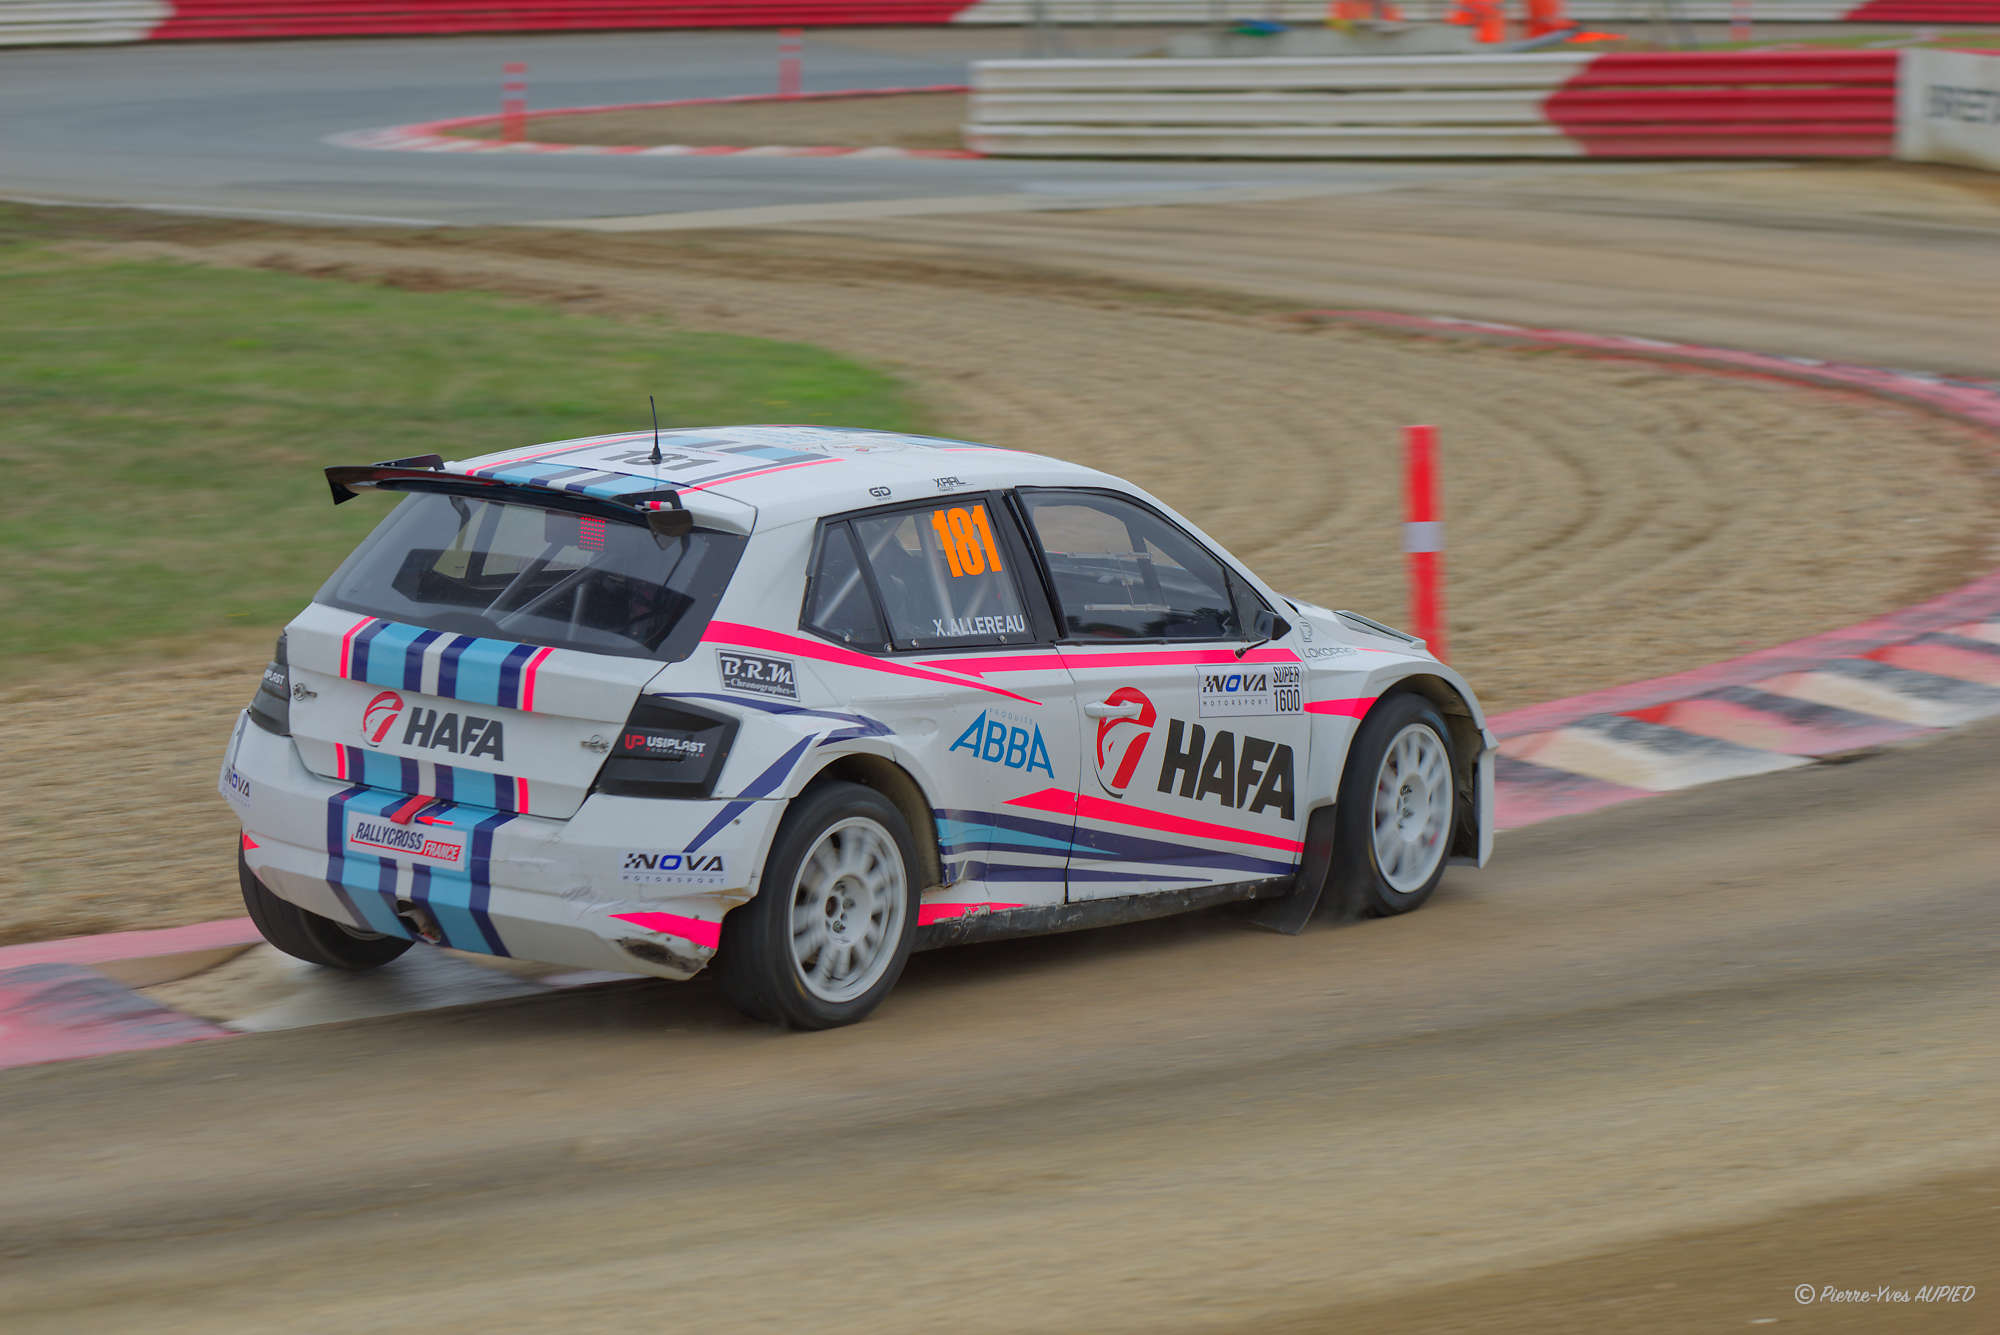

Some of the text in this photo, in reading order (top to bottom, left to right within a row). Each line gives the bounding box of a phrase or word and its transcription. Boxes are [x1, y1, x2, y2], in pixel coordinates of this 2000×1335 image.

[932, 505, 1002, 578] 181
[932, 614, 1025, 637] X.ALLEREAU
[1203, 674, 1267, 692] NOVA
[1273, 666, 1300, 684] SUPER
[1273, 689, 1300, 712] 1600
[402, 706, 504, 762] HAFA
[646, 735, 706, 752] USIPLAST
[949, 708, 1055, 779] ABBA
[1157, 718, 1295, 821] HAFA
[355, 822, 460, 860] RALLYCROSS FRANCE
[624, 853, 723, 871] NOVA
